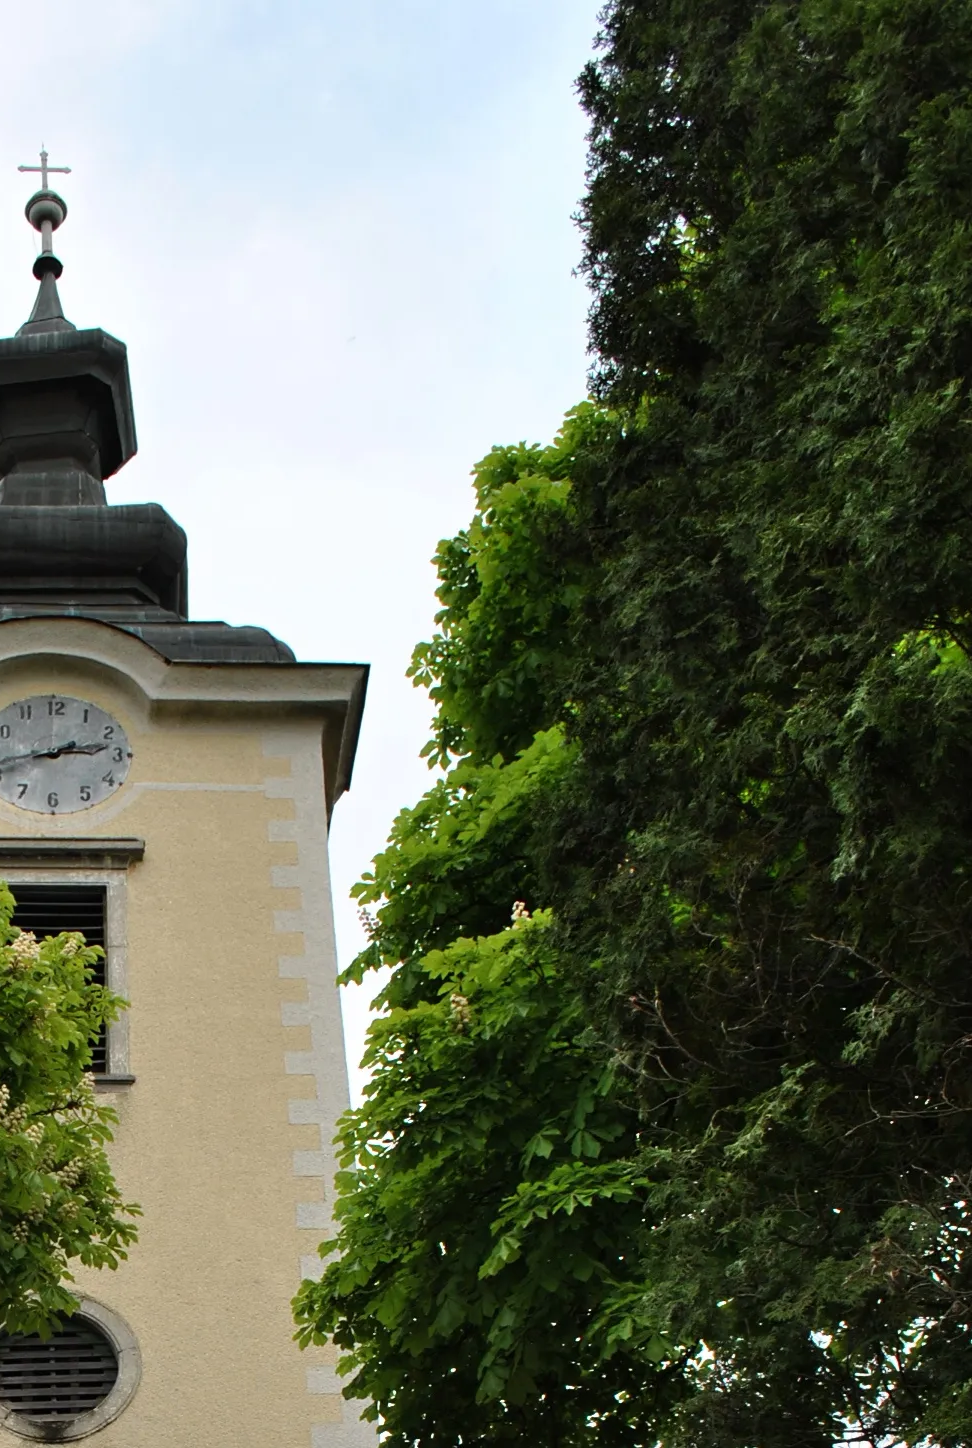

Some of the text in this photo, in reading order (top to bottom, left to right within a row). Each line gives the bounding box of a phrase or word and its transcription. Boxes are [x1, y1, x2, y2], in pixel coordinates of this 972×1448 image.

[19, 704, 32, 720] 11
[47, 701, 65, 716] 12
[83, 708, 89, 723] 1
[103, 726, 114, 740] 2
[112, 747, 123, 762] 3
[101, 770, 115, 786] 4
[17, 783, 28, 799] 7
[79, 785, 91, 801] 5
[47, 792, 59, 808] 6
